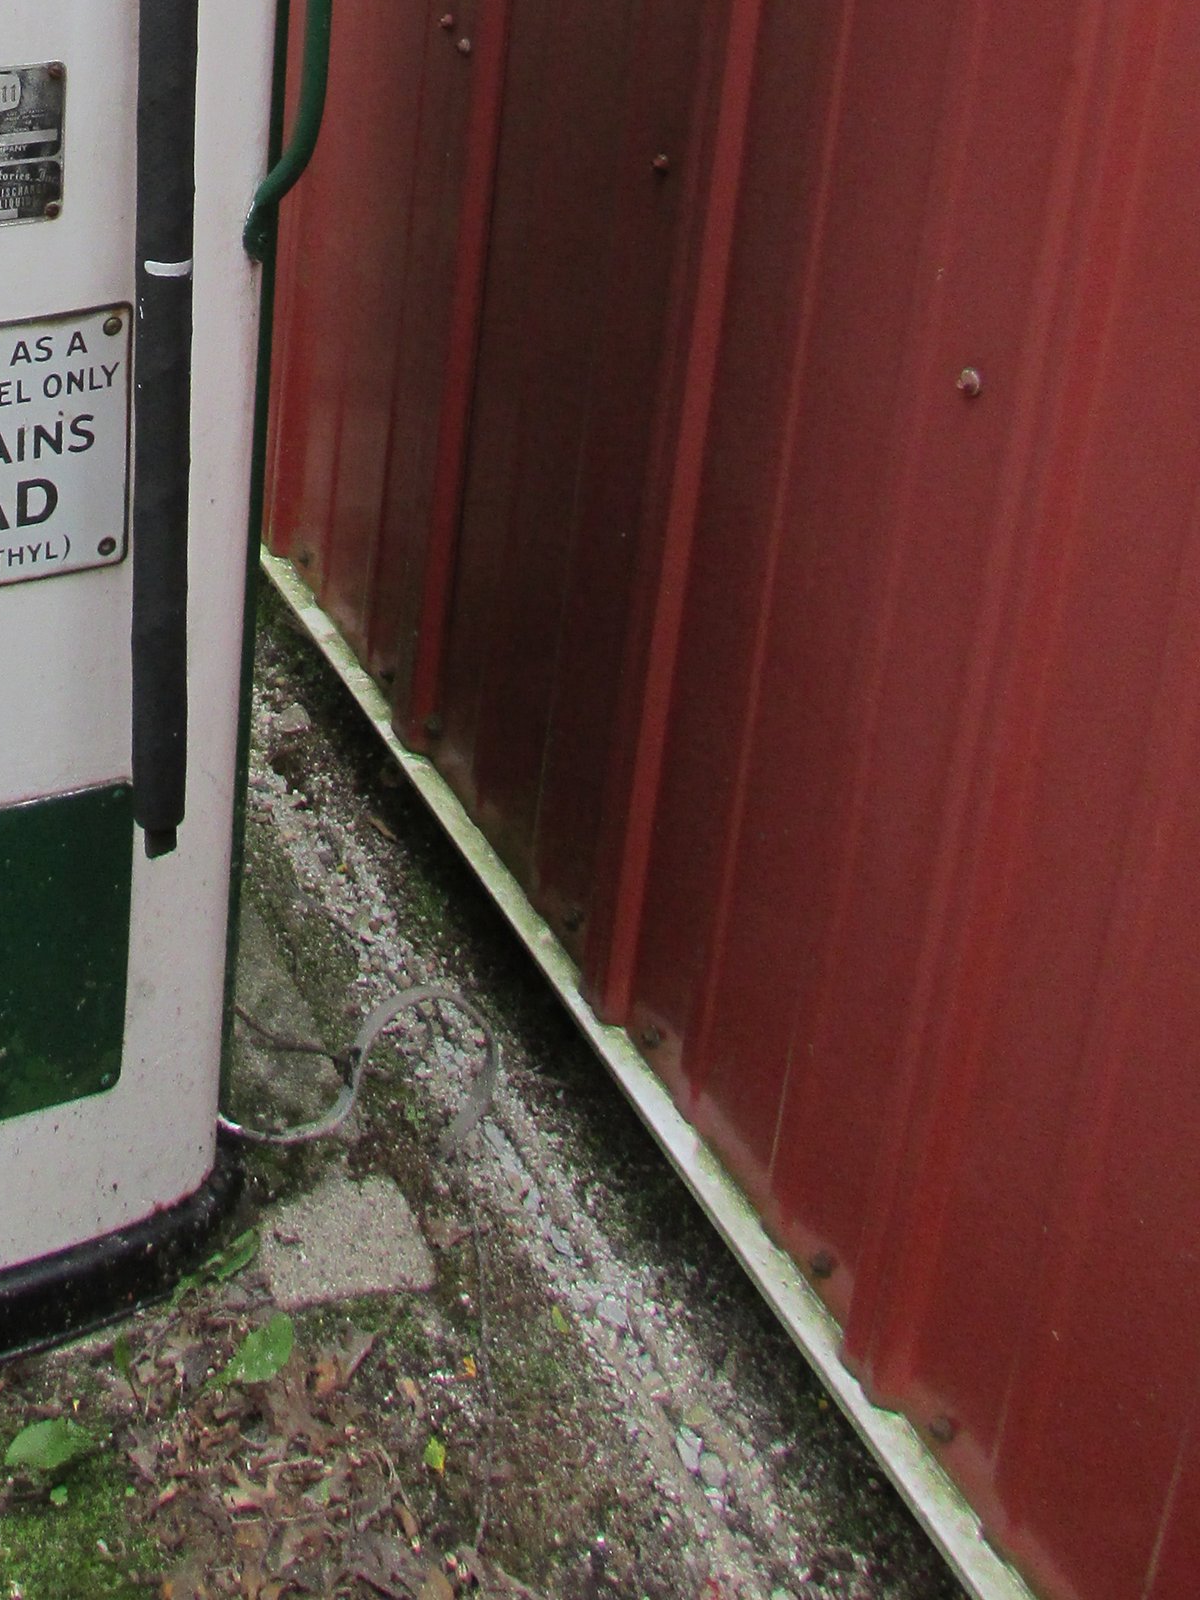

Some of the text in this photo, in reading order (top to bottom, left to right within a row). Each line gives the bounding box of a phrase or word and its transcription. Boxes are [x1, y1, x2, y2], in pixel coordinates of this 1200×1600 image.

[10, 336, 54, 367] AS
[66, 331, 88, 357] A
[43, 362, 121, 398] ONLY
